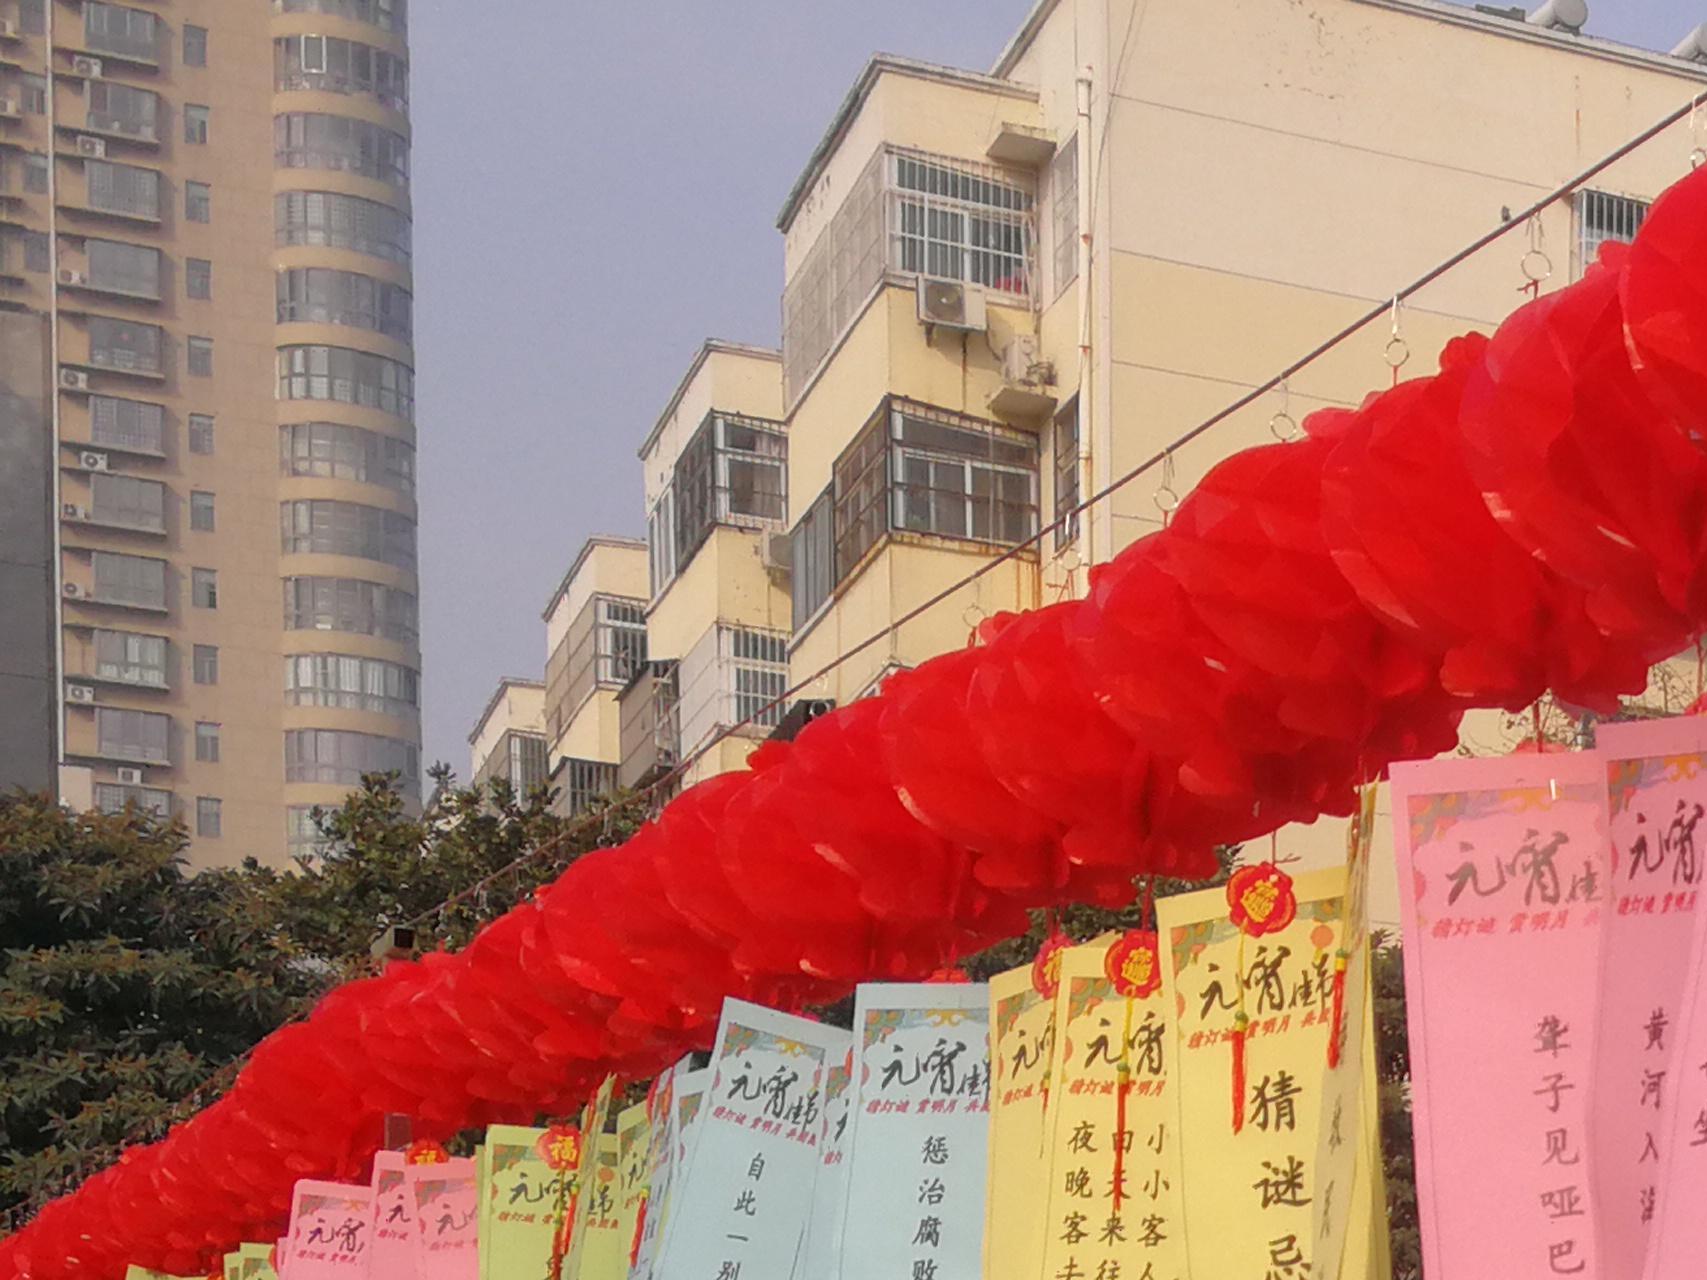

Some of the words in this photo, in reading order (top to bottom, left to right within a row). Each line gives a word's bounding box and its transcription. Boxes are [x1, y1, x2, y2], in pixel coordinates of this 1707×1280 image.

[549, 1135, 577, 1160] 福
[1533, 1015, 1586, 1275] 聋子见哑巴
